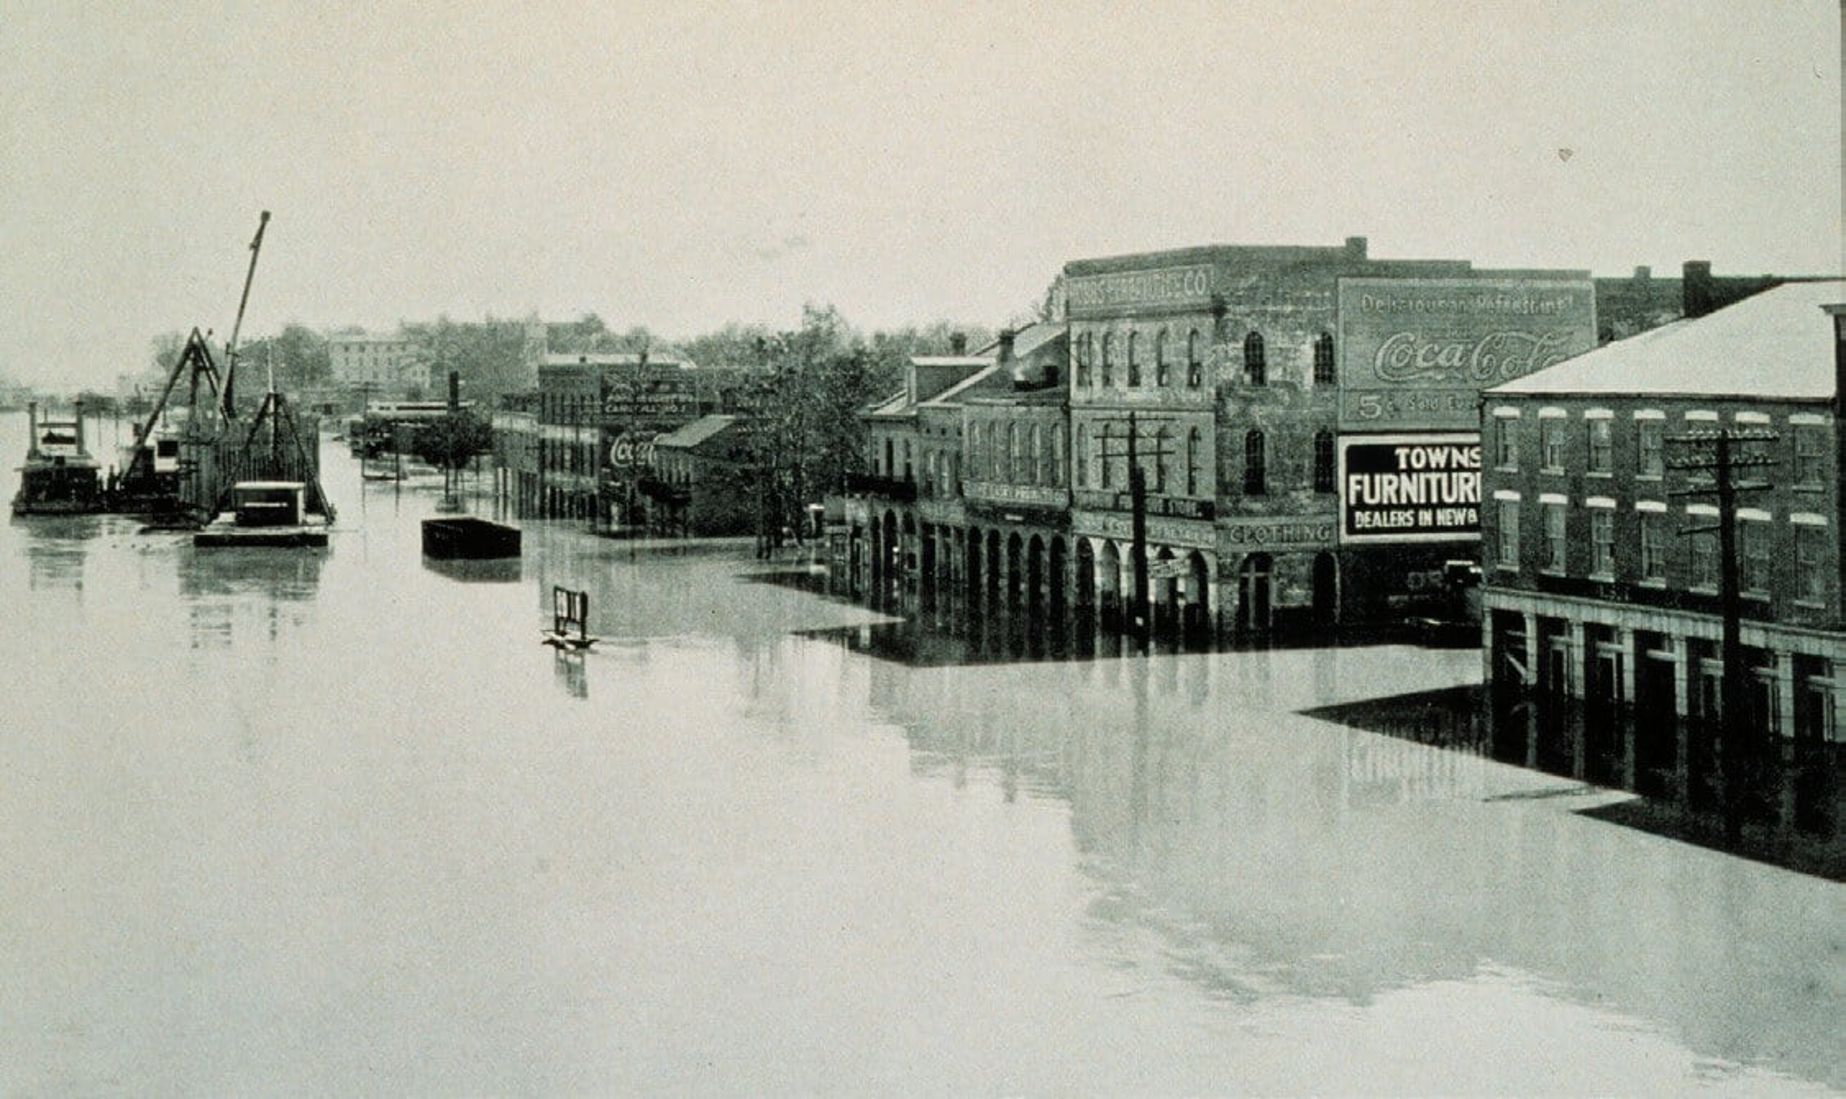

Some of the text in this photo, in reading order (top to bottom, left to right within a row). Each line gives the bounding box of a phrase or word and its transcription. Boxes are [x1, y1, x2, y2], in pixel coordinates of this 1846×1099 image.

[1374, 331, 1468, 382] Coca
[1394, 446, 1481, 470] TOWNS
[1354, 509, 1415, 529] DEALERS
[1418, 508, 1433, 527] IN
[1436, 508, 1466, 527] NEW
[1230, 524, 1331, 543] CLOTHING
